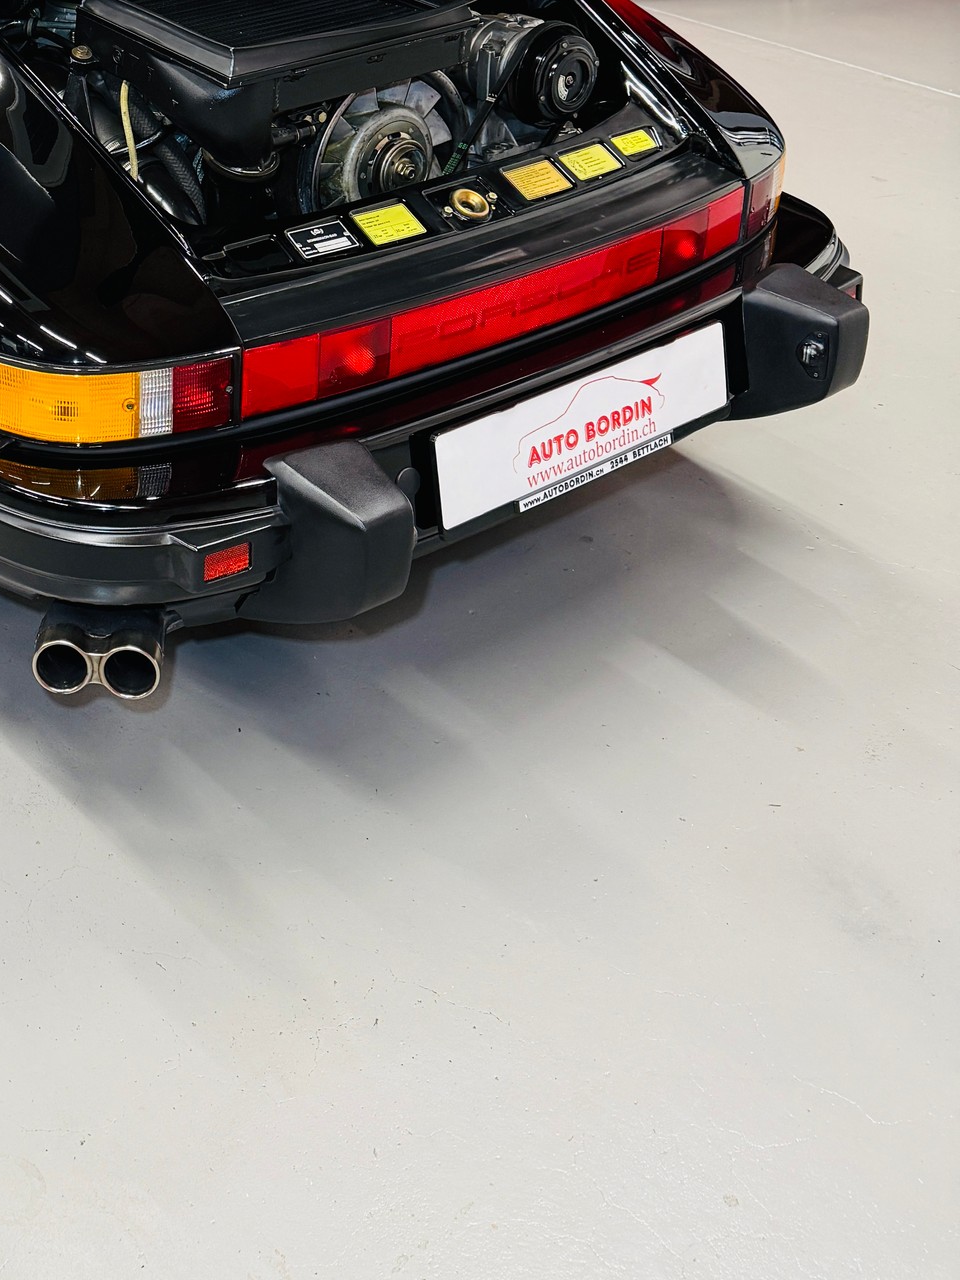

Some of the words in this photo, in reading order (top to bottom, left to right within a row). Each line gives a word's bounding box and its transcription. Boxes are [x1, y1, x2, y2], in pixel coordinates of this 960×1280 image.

[396, 248, 658, 354] PORSCHE
[527, 429, 579, 469] AUTO
[584, 396, 653, 443] BORDIN
[527, 418, 657, 488] www.autobordin.ch
[609, 455, 629, 470] 2544
[632, 436, 669, 459] BETTLACH
